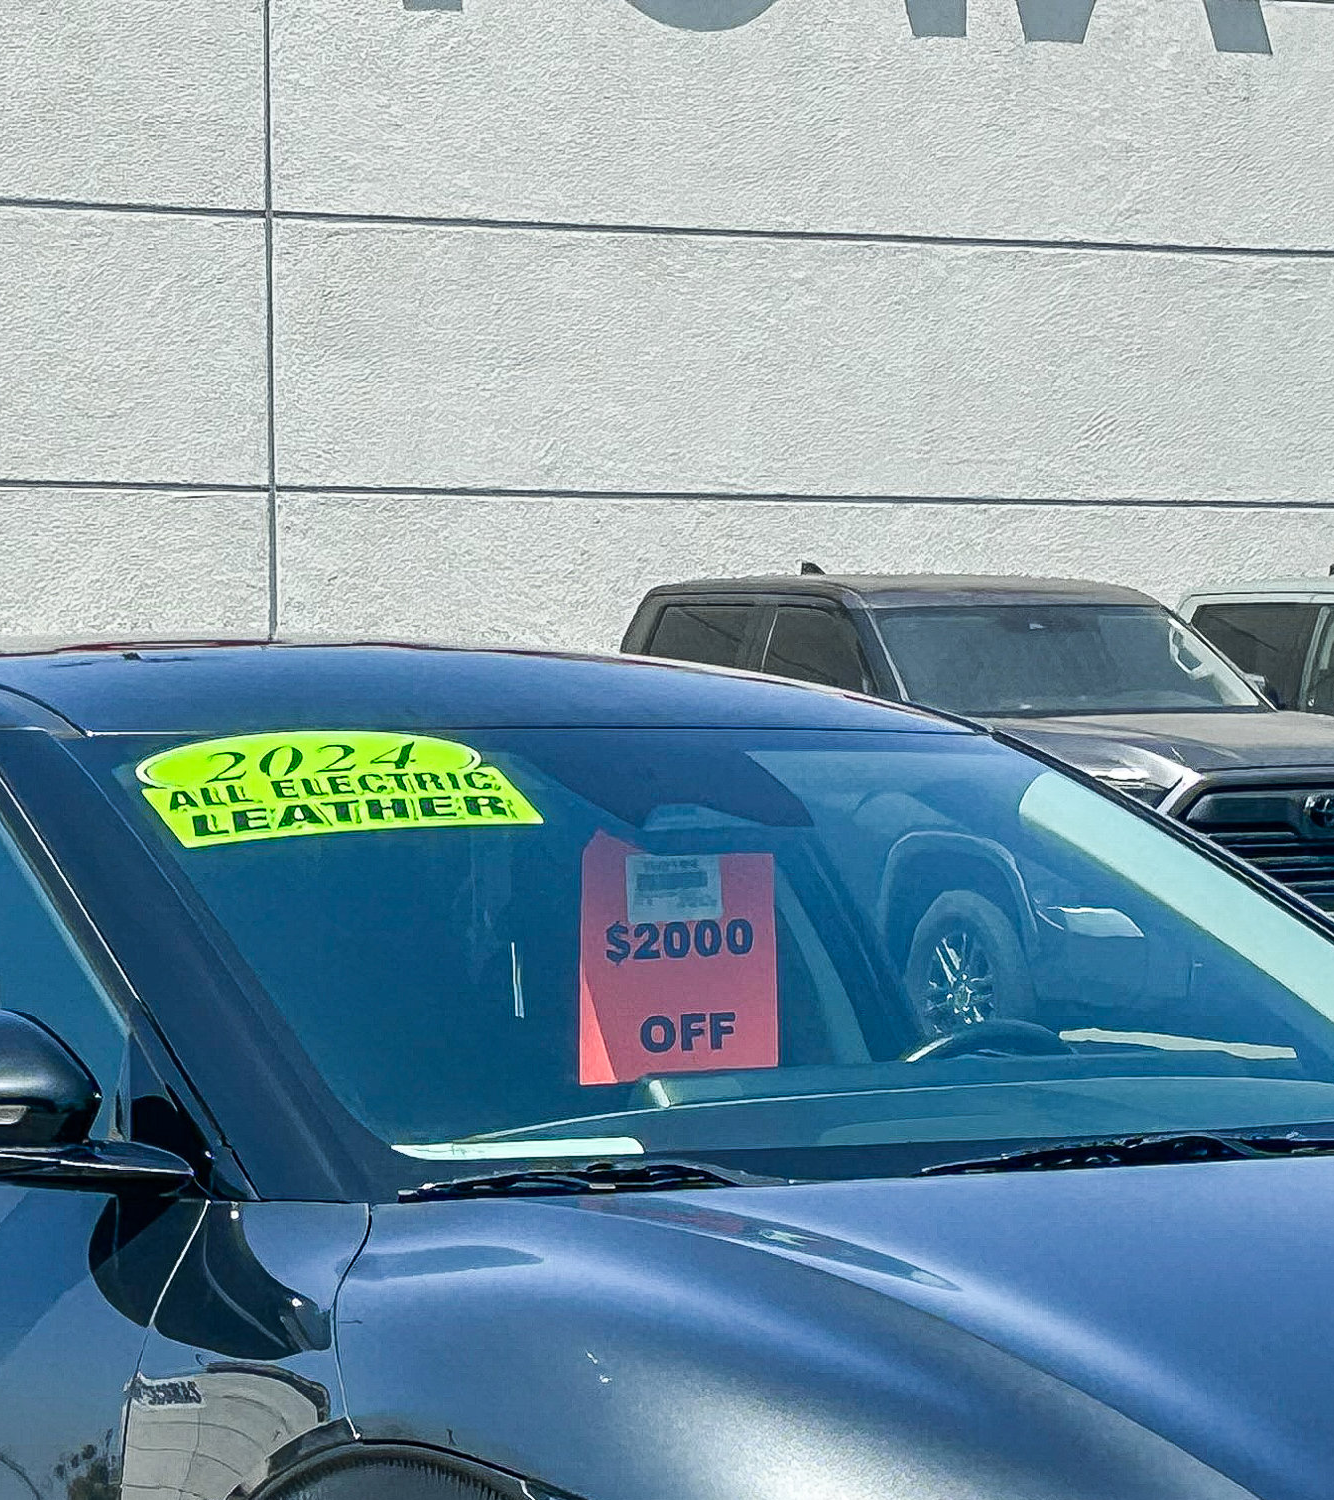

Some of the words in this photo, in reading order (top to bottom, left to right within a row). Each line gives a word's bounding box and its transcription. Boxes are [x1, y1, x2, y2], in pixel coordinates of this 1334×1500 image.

[206, 741, 416, 783] 2024
[170, 786, 254, 811] ALL
[270, 771, 501, 799] ELECTRIC
[193, 796, 514, 837] LEATHER
[606, 919, 753, 966] $2000
[640, 1012, 736, 1053] OFF
